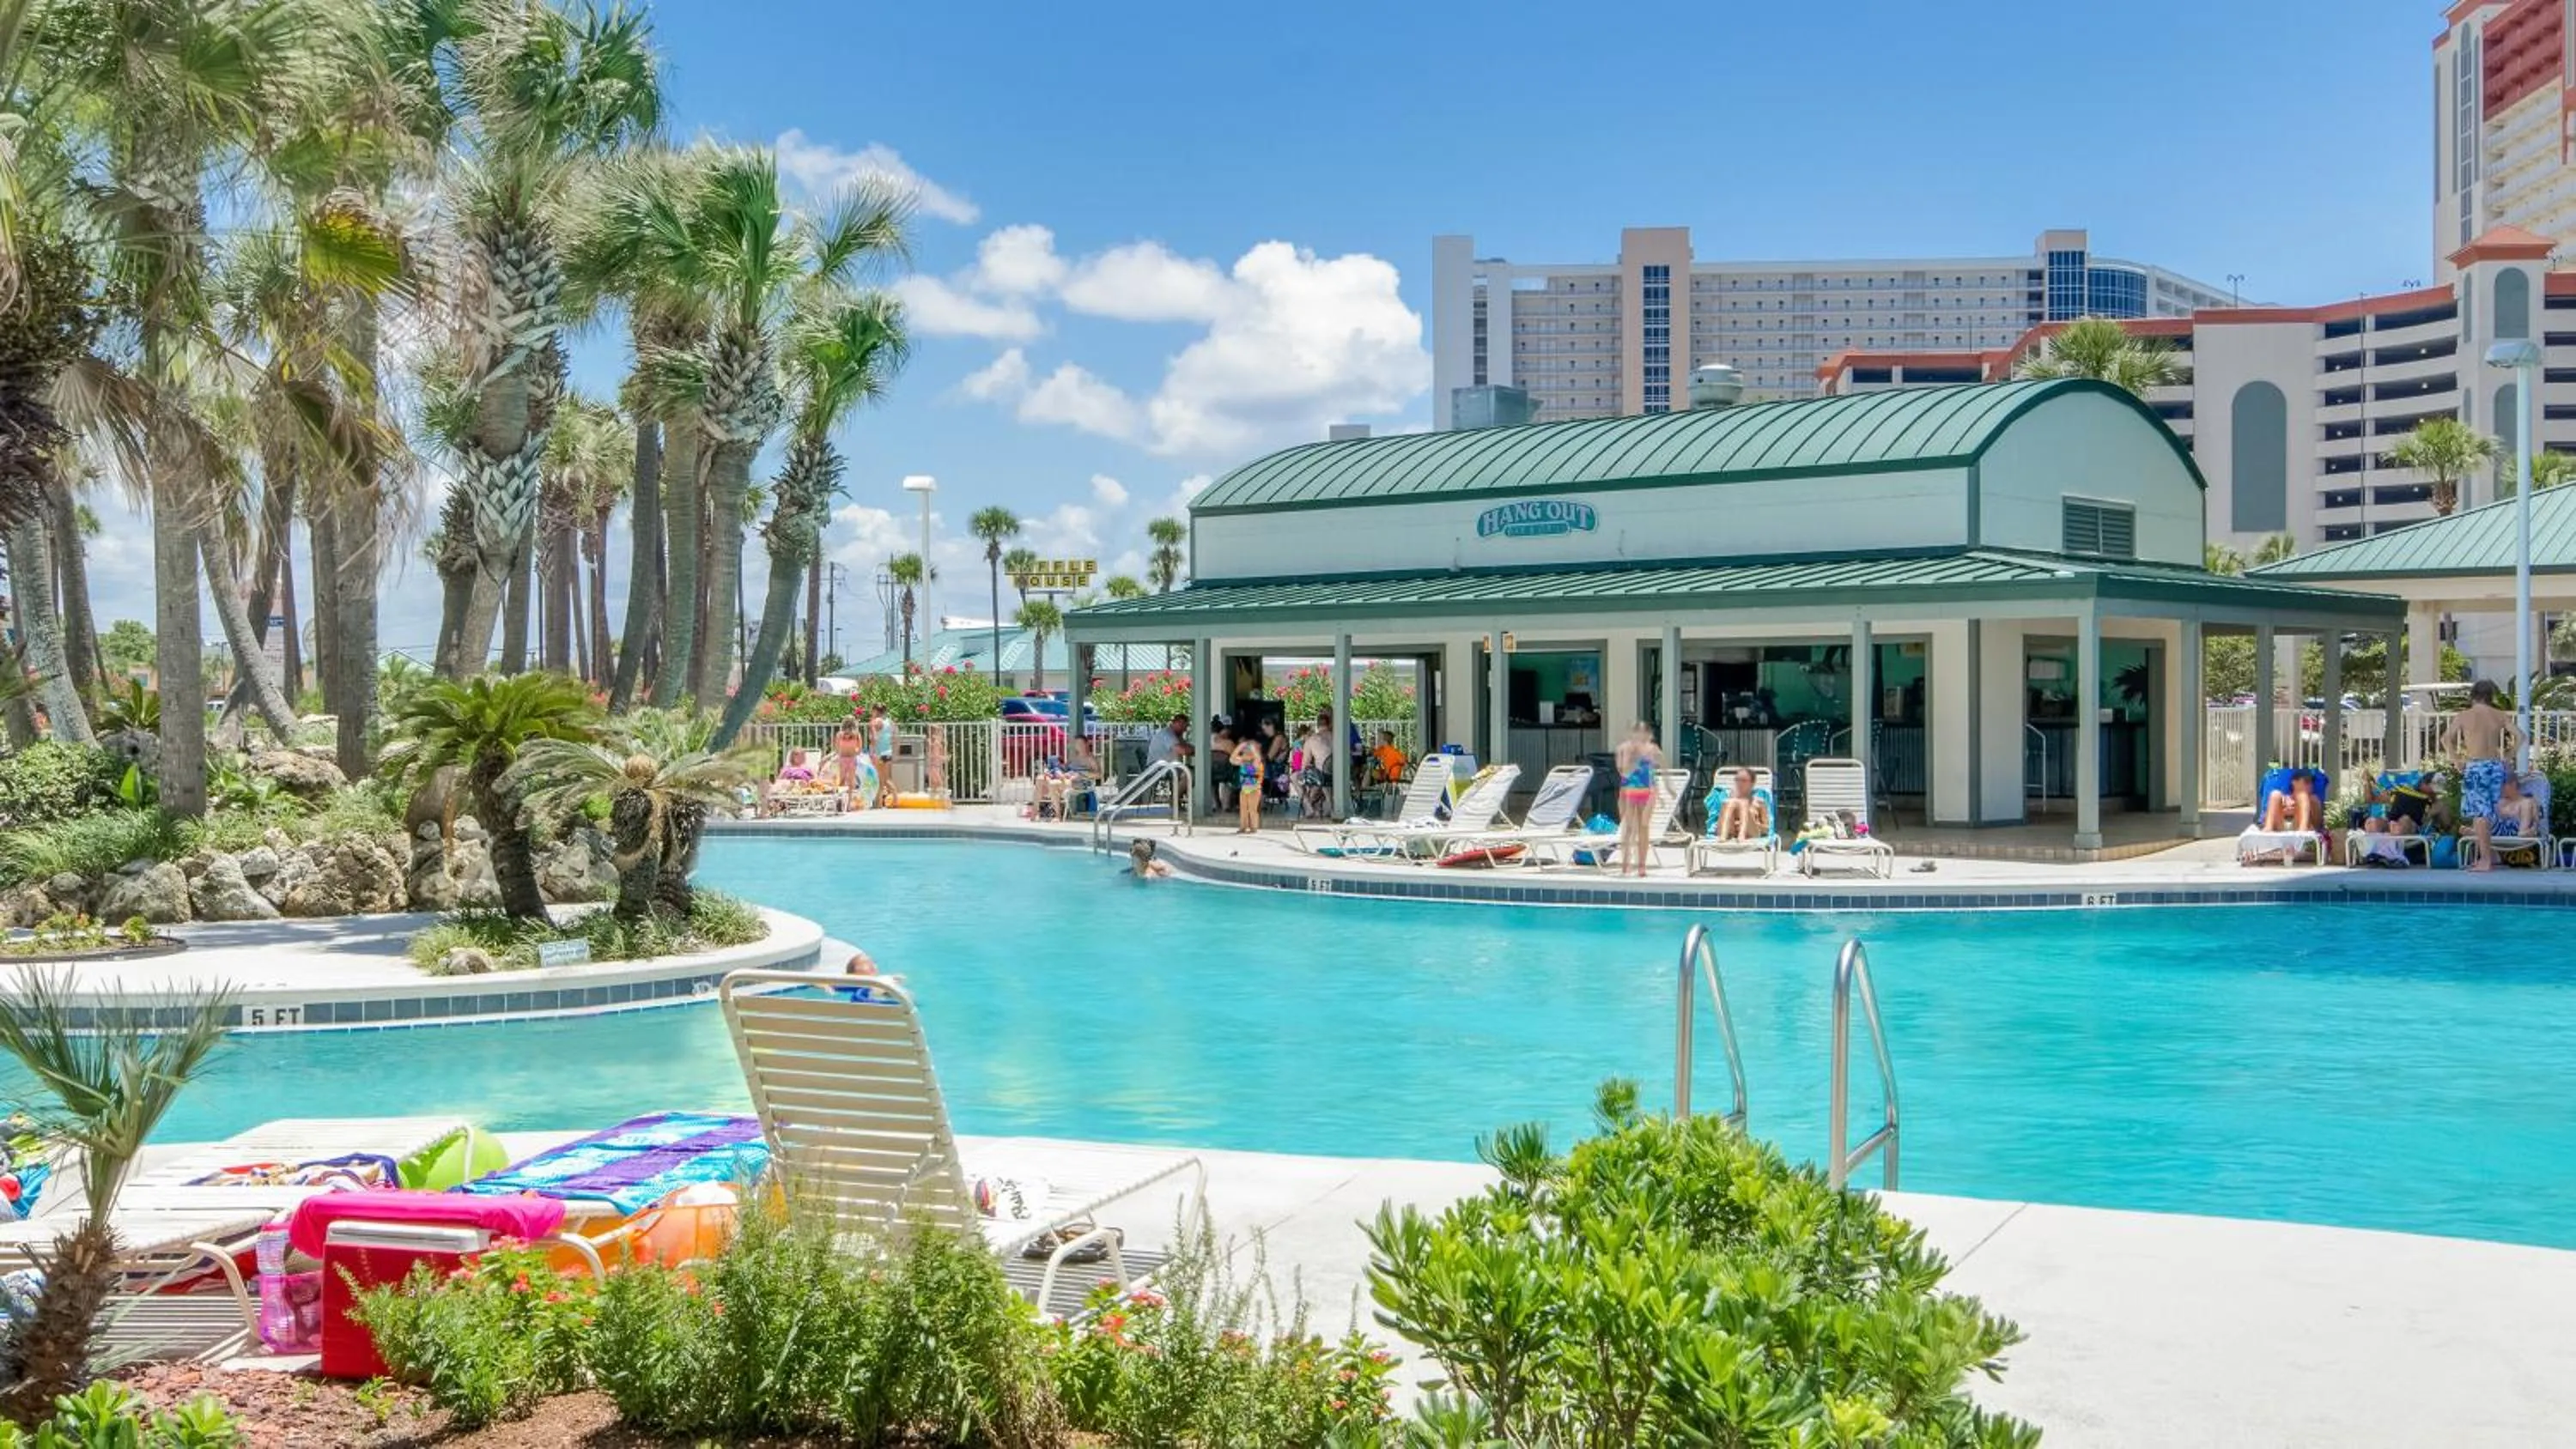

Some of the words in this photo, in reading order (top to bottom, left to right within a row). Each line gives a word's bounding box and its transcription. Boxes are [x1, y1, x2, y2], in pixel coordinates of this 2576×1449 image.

[1483, 502, 1541, 535] HANG
[1547, 501, 1589, 528] OUT
[1015, 576, 1086, 586] OUSE
[2099, 895, 2117, 906] FT
[252, 1009, 264, 1026] 5
[276, 1008, 301, 1025] FT
